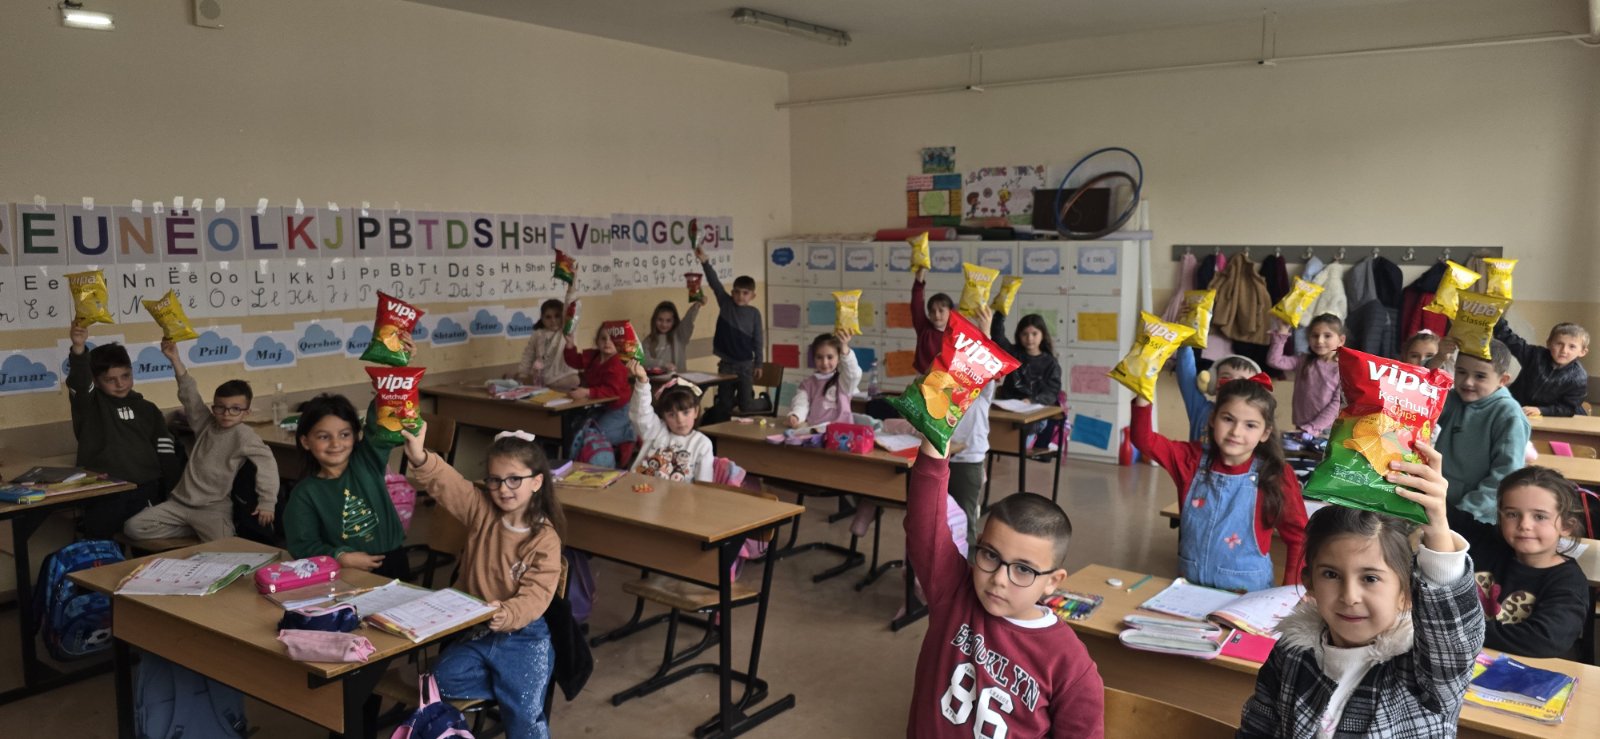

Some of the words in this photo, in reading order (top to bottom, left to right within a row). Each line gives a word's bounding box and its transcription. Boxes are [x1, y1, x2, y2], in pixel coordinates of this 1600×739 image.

[22, 213, 58, 253] E
[73, 216, 108, 255] U
[119, 217, 154, 254] N
[166, 210, 198, 254] Ë
[208, 218, 239, 251] O
[251, 216, 278, 250] L
[287, 216, 318, 250] K
[323, 216, 343, 249] J
[358, 217, 380, 249] P
[389, 218, 412, 249] B
[418, 219, 439, 250] T
[446, 220, 468, 249] D
[474, 218, 493, 248] S
[501, 221, 519, 249] H
[522, 226, 546, 244] SH
[551, 223, 565, 249] F
[571, 222, 589, 250] V
[590, 228, 611, 244] DH
[611, 224, 630, 240] RR
[633, 219, 648, 244] Q
[652, 220, 667, 244] G
[670, 220, 685, 245] C
[24, 275, 38, 290] E
[48, 279, 59, 289] e
[123, 273, 136, 288] N
[145, 276, 155, 287] n
[168, 267, 180, 284] Ë
[189, 271, 198, 283] ë
[210, 271, 222, 284] O
[229, 273, 238, 283] o
[255, 270, 264, 284] L
[290, 272, 299, 284] K
[306, 272, 314, 284] k
[327, 266, 334, 280] J
[360, 267, 369, 279] P
[373, 268, 379, 278] p
[390, 263, 400, 277] B
[406, 264, 413, 276] b
[418, 263, 426, 275] T
[448, 263, 459, 277] D
[462, 265, 469, 277] d
[476, 264, 484, 276] S
[489, 267, 495, 276] s
[501, 262, 509, 272] H
[387, 300, 416, 320] vipa
[1462, 300, 1497, 317] vipa
[1460, 314, 1489, 327] Classic
[607, 326, 625, 338] vipa
[1143, 322, 1178, 342] vipa
[199, 345, 228, 357] Prill
[300, 339, 342, 351] Qershor
[954, 332, 1003, 376] vipa
[255, 349, 283, 361] Maj
[138, 362, 173, 373] Mars
[952, 359, 984, 385] Ketchup
[0, 373, 48, 386] Janar
[377, 374, 414, 392] vipa
[955, 369, 973, 386] Chips
[1367, 360, 1438, 400] vipa
[1378, 390, 1429, 417] Ketchup
[941, 662, 1014, 739] 86
